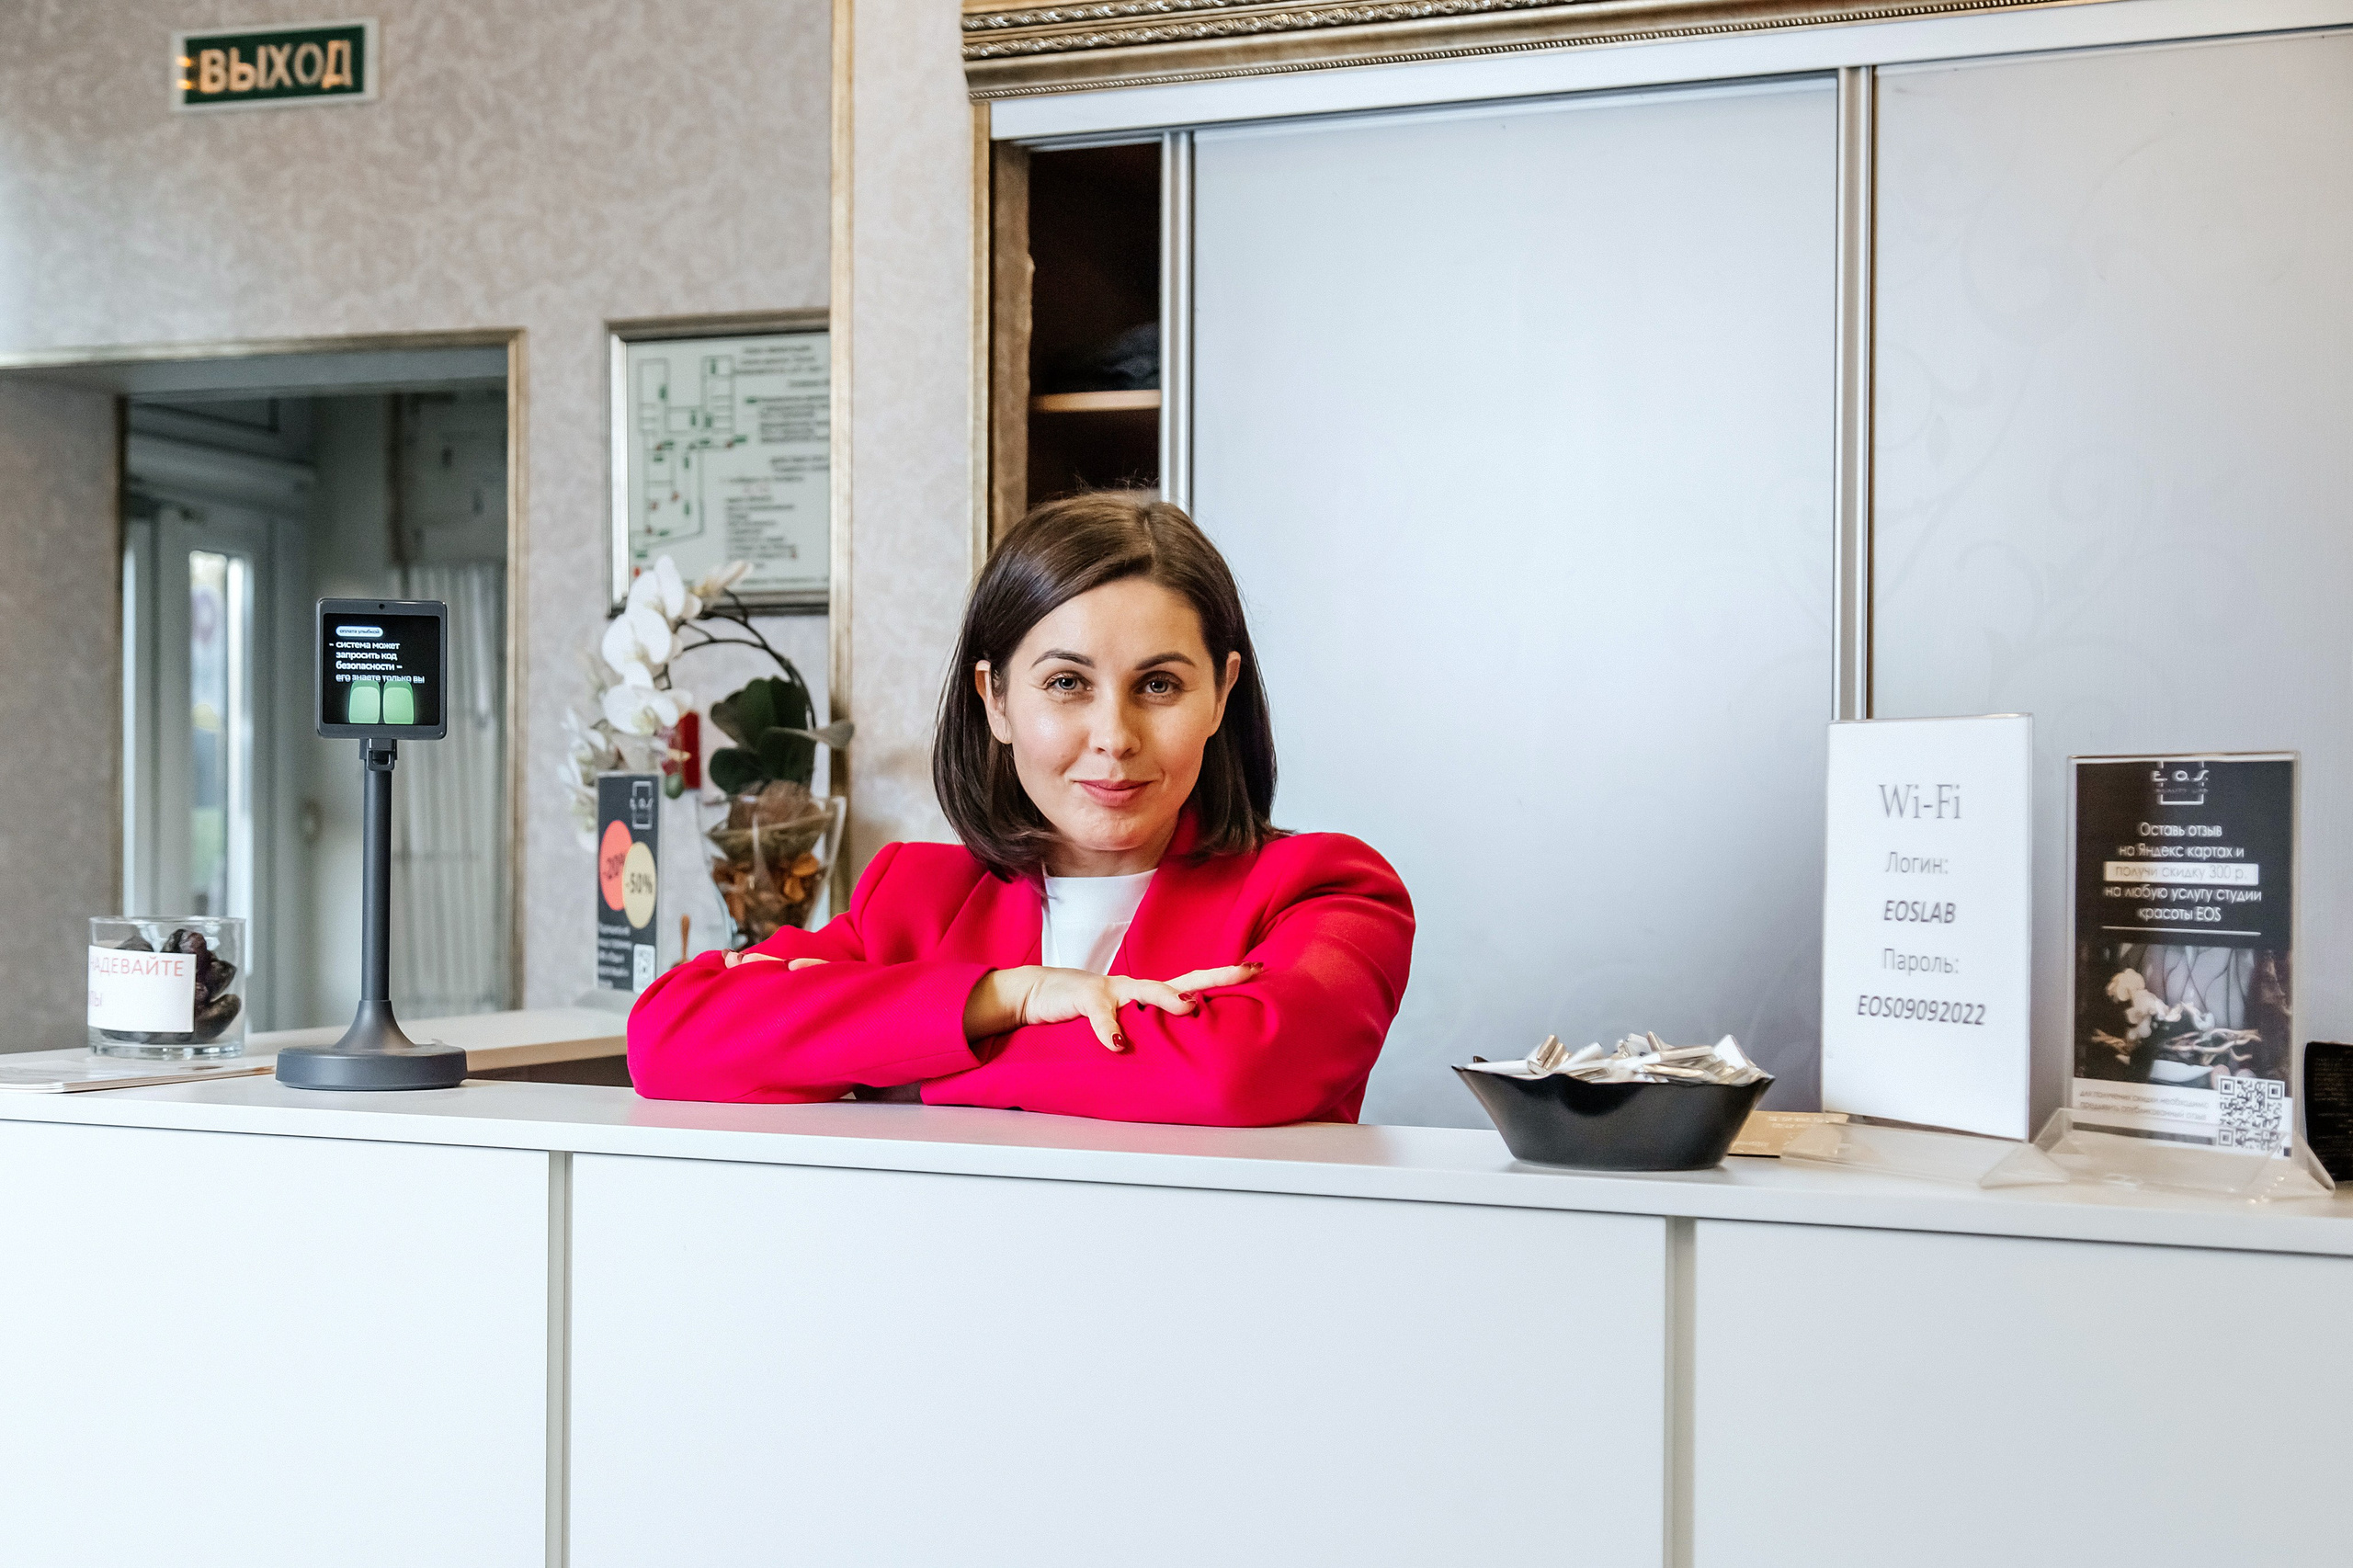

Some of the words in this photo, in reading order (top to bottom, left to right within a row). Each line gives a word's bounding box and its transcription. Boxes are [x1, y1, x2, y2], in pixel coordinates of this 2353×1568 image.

[199, 40, 353, 94] ВЫХОД
[372, 642, 400, 650] может
[335, 651, 381, 661] запросить
[381, 652, 398, 661] код
[335, 660, 395, 671] безопасности
[335, 674, 351, 683] его
[352, 674, 381, 682] знаете
[382, 675, 412, 683] только
[413, 675, 426, 684] вы
[1879, 784, 1961, 819] Wi-Fi
[2138, 822, 2185, 837] Оставь
[2187, 824, 2222, 837] отзыв
[2118, 846, 2135, 858] на
[2137, 842, 2185, 858] Яндекс
[2187, 846, 2234, 860] картах
[2235, 846, 2245, 858] и
[1885, 851, 1949, 875] Логин:
[2115, 866, 2158, 881] получи
[2162, 867, 2205, 881] скидку
[2209, 864, 2231, 879] 300
[624, 871, 654, 894] -50%
[2104, 886, 2121, 898] на
[2124, 883, 2168, 901] любую
[2171, 887, 2213, 903] услугу
[2215, 888, 2262, 903] студии
[1883, 900, 1957, 924] EOSLAB
[2138, 907, 2193, 922] красоты
[2195, 905, 2222, 923] EOS
[1883, 948, 1960, 976] Пароль:
[1857, 994, 1986, 1026] EOS09092022
